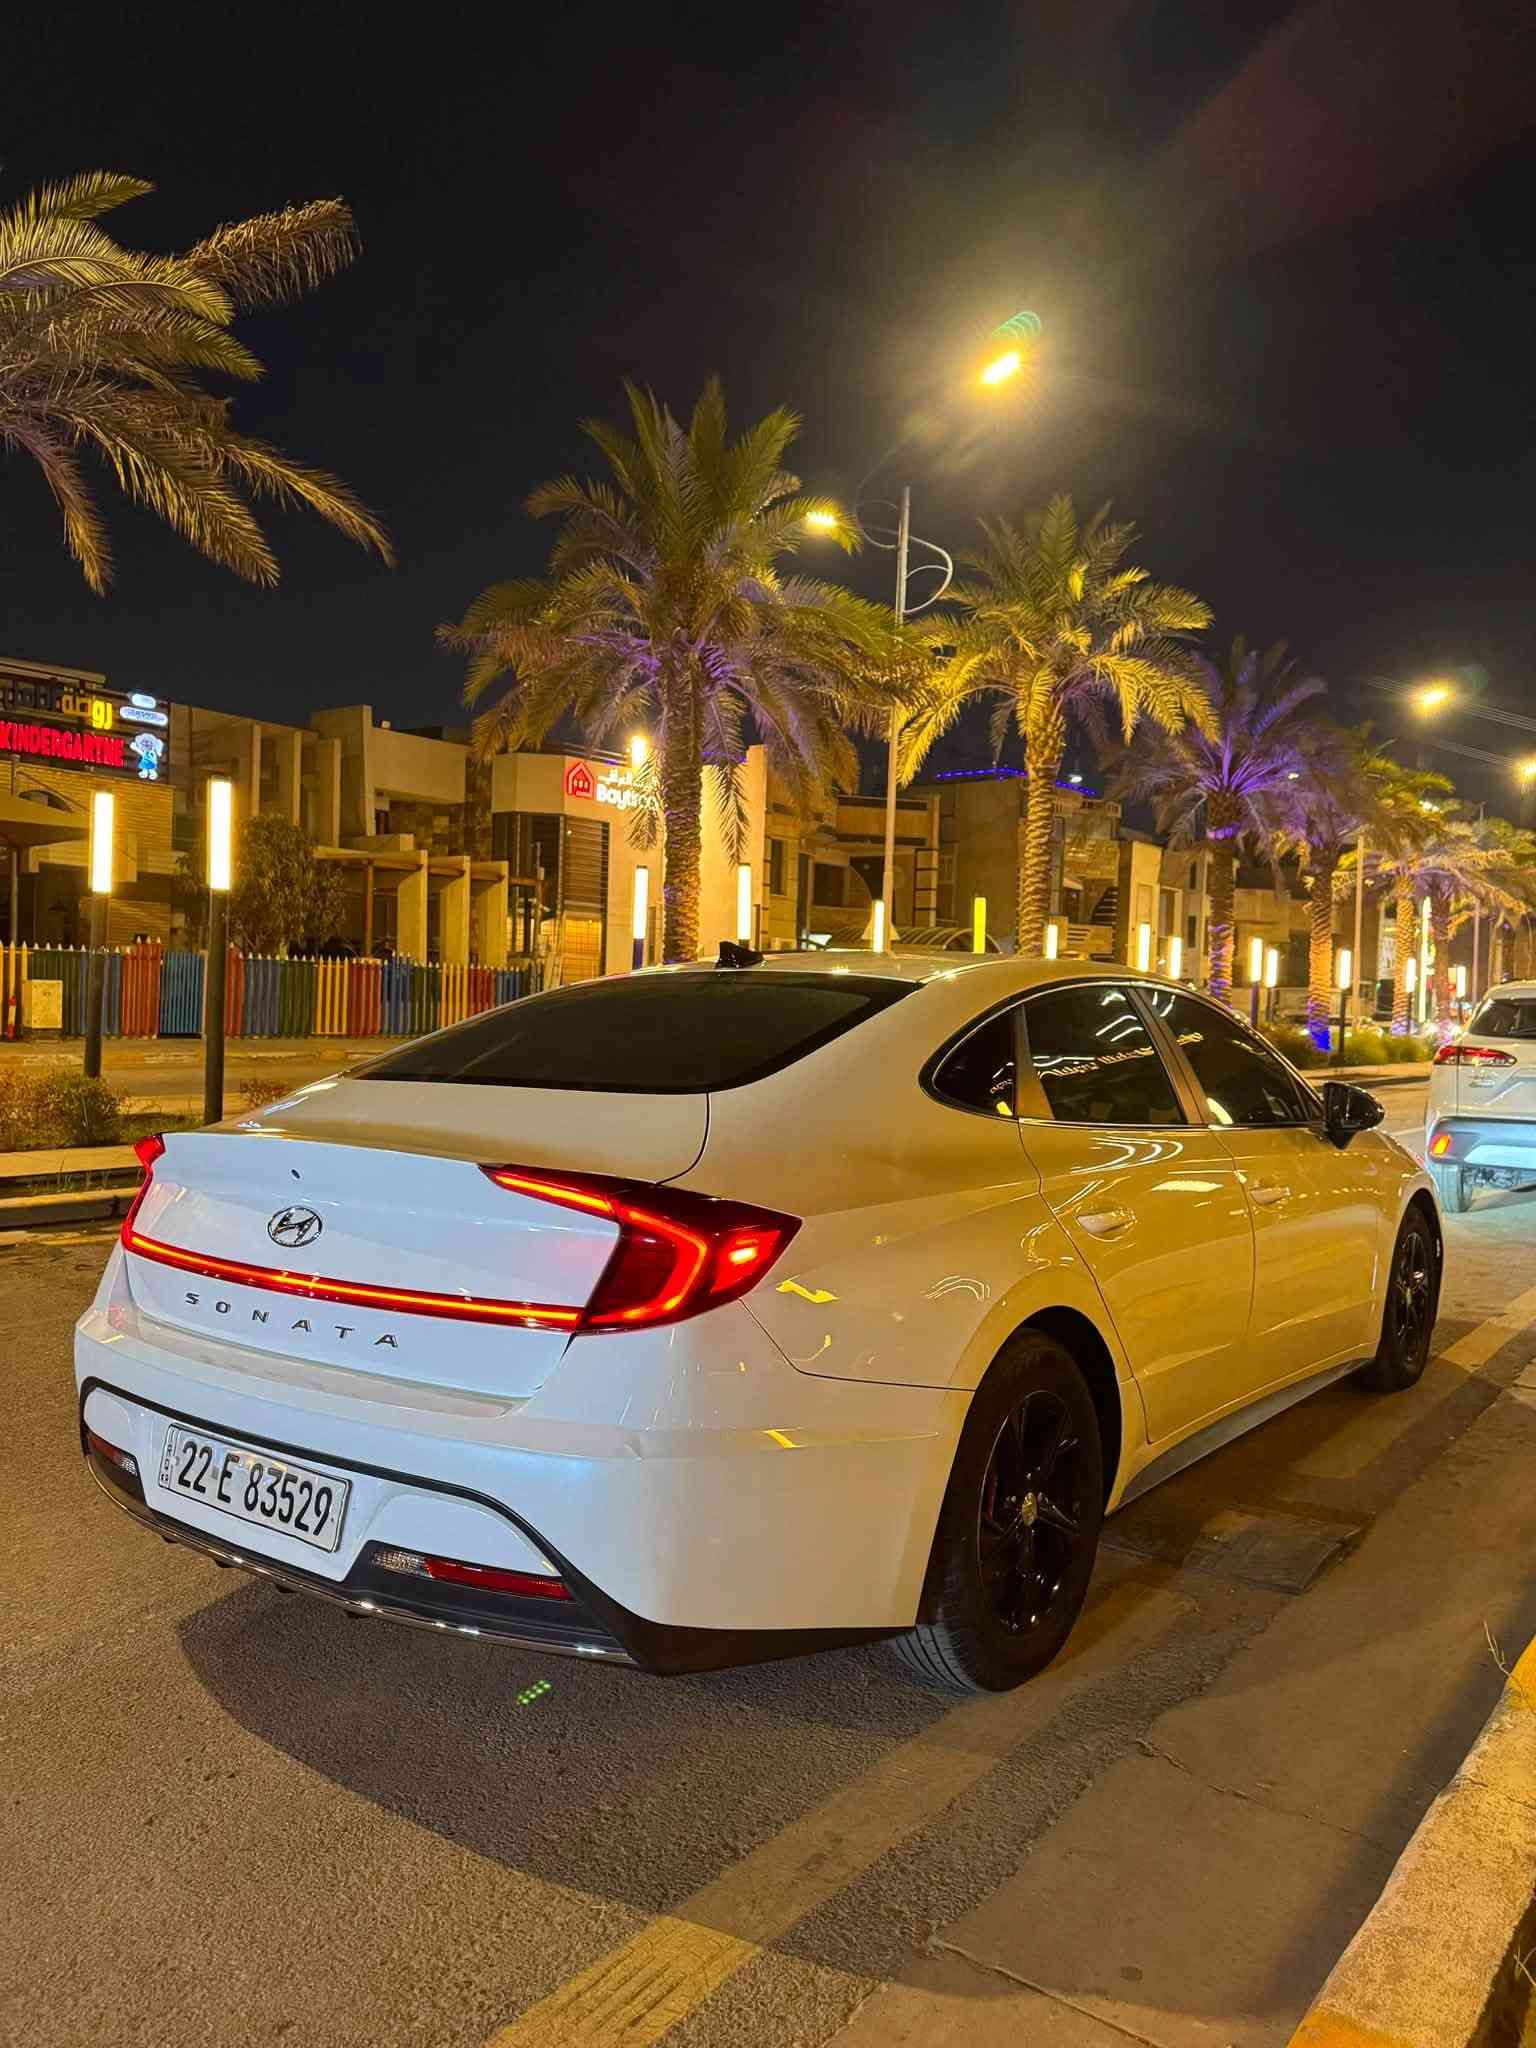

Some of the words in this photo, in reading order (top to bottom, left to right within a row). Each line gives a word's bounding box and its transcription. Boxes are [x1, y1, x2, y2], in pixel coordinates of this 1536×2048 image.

[184, 1292, 399, 1349] SONATA
[178, 1440, 213, 1494] 22
[216, 1452, 239, 1504] E
[243, 1463, 333, 1537] 83529
